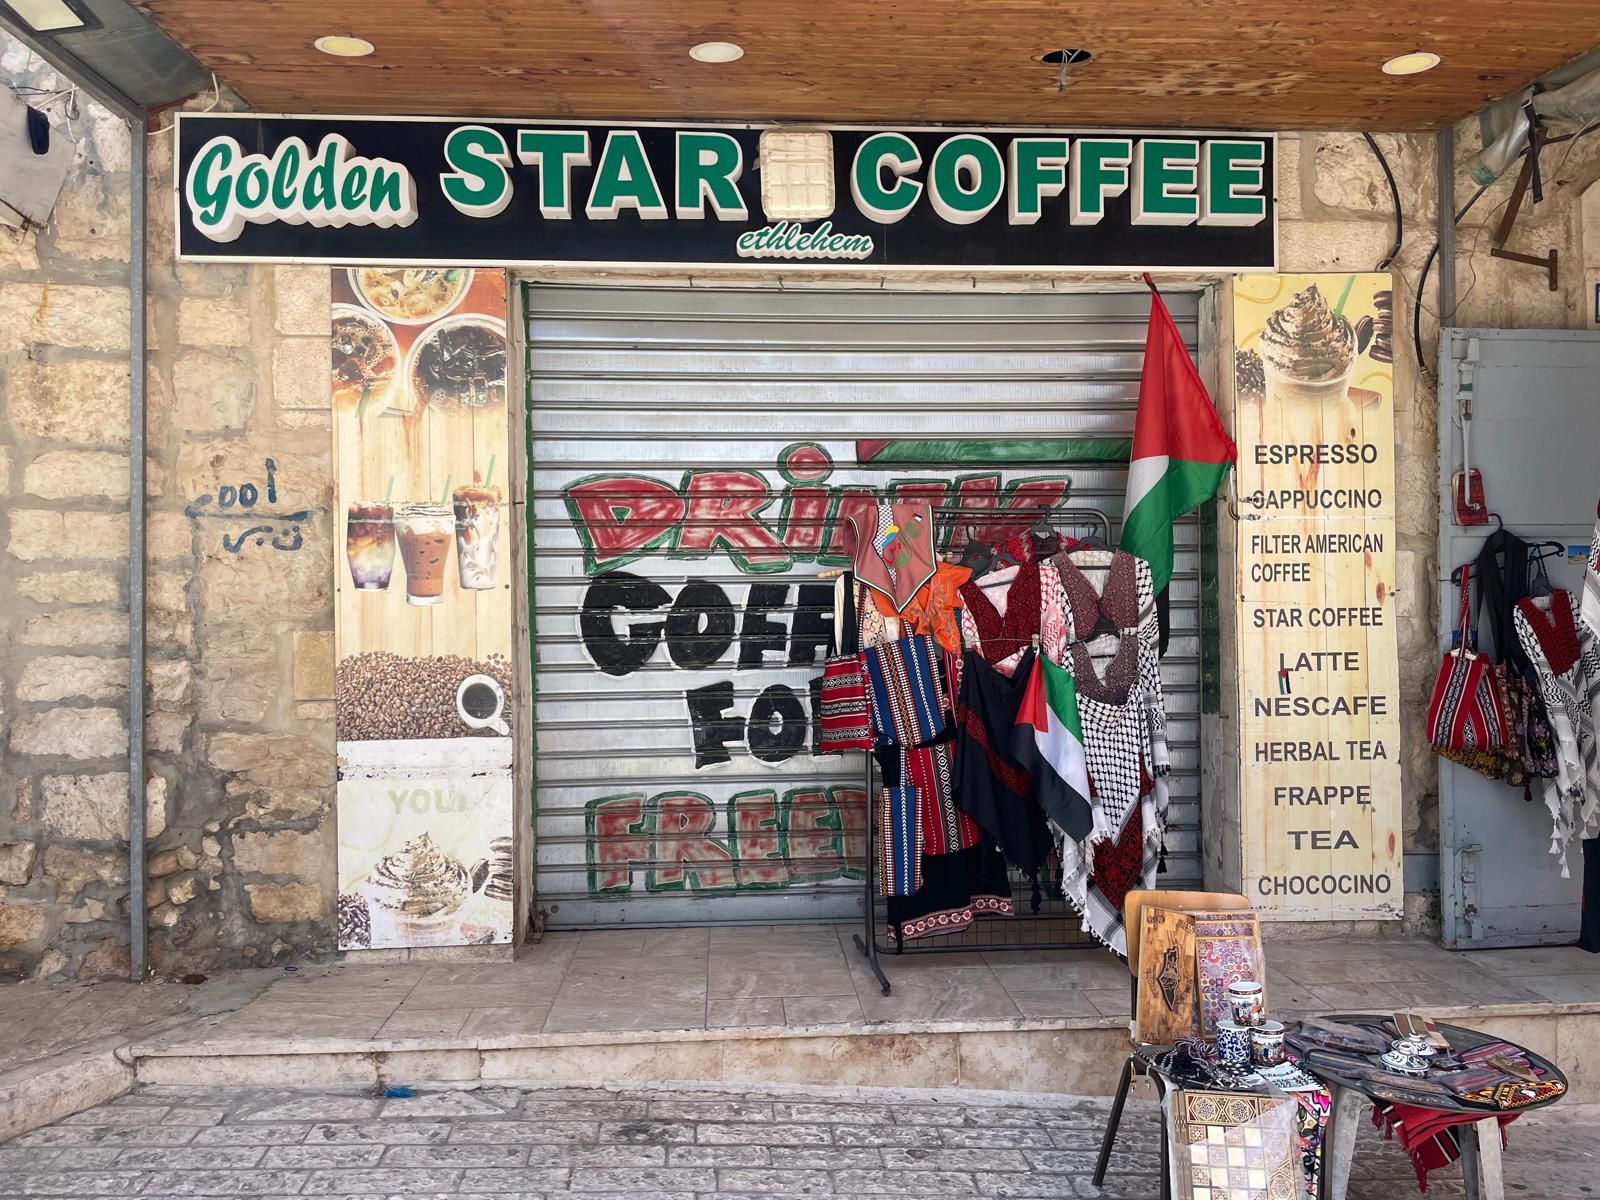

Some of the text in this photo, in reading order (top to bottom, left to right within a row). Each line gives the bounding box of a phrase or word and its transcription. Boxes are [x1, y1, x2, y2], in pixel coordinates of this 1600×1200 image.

[187, 126, 1266, 236] Golden STAR COFFEE
[737, 222, 872, 259] ethlehem
[1254, 444, 1378, 465] ESPRESSO
[1252, 489, 1382, 510] CAPPUCCINO
[1251, 533, 1383, 554] FILTER AMERICAN
[1251, 562, 1311, 583] COFFEE
[1253, 607, 1383, 628] STAR COFFEE
[1279, 651, 1360, 672] LATTE
[1254, 695, 1387, 717] NESCAFE
[1255, 740, 1388, 762] HERBAL TEA
[1273, 785, 1372, 806] FRAPPE
[1286, 830, 1360, 850] TEA
[1257, 874, 1391, 896] CHOCOCINO
